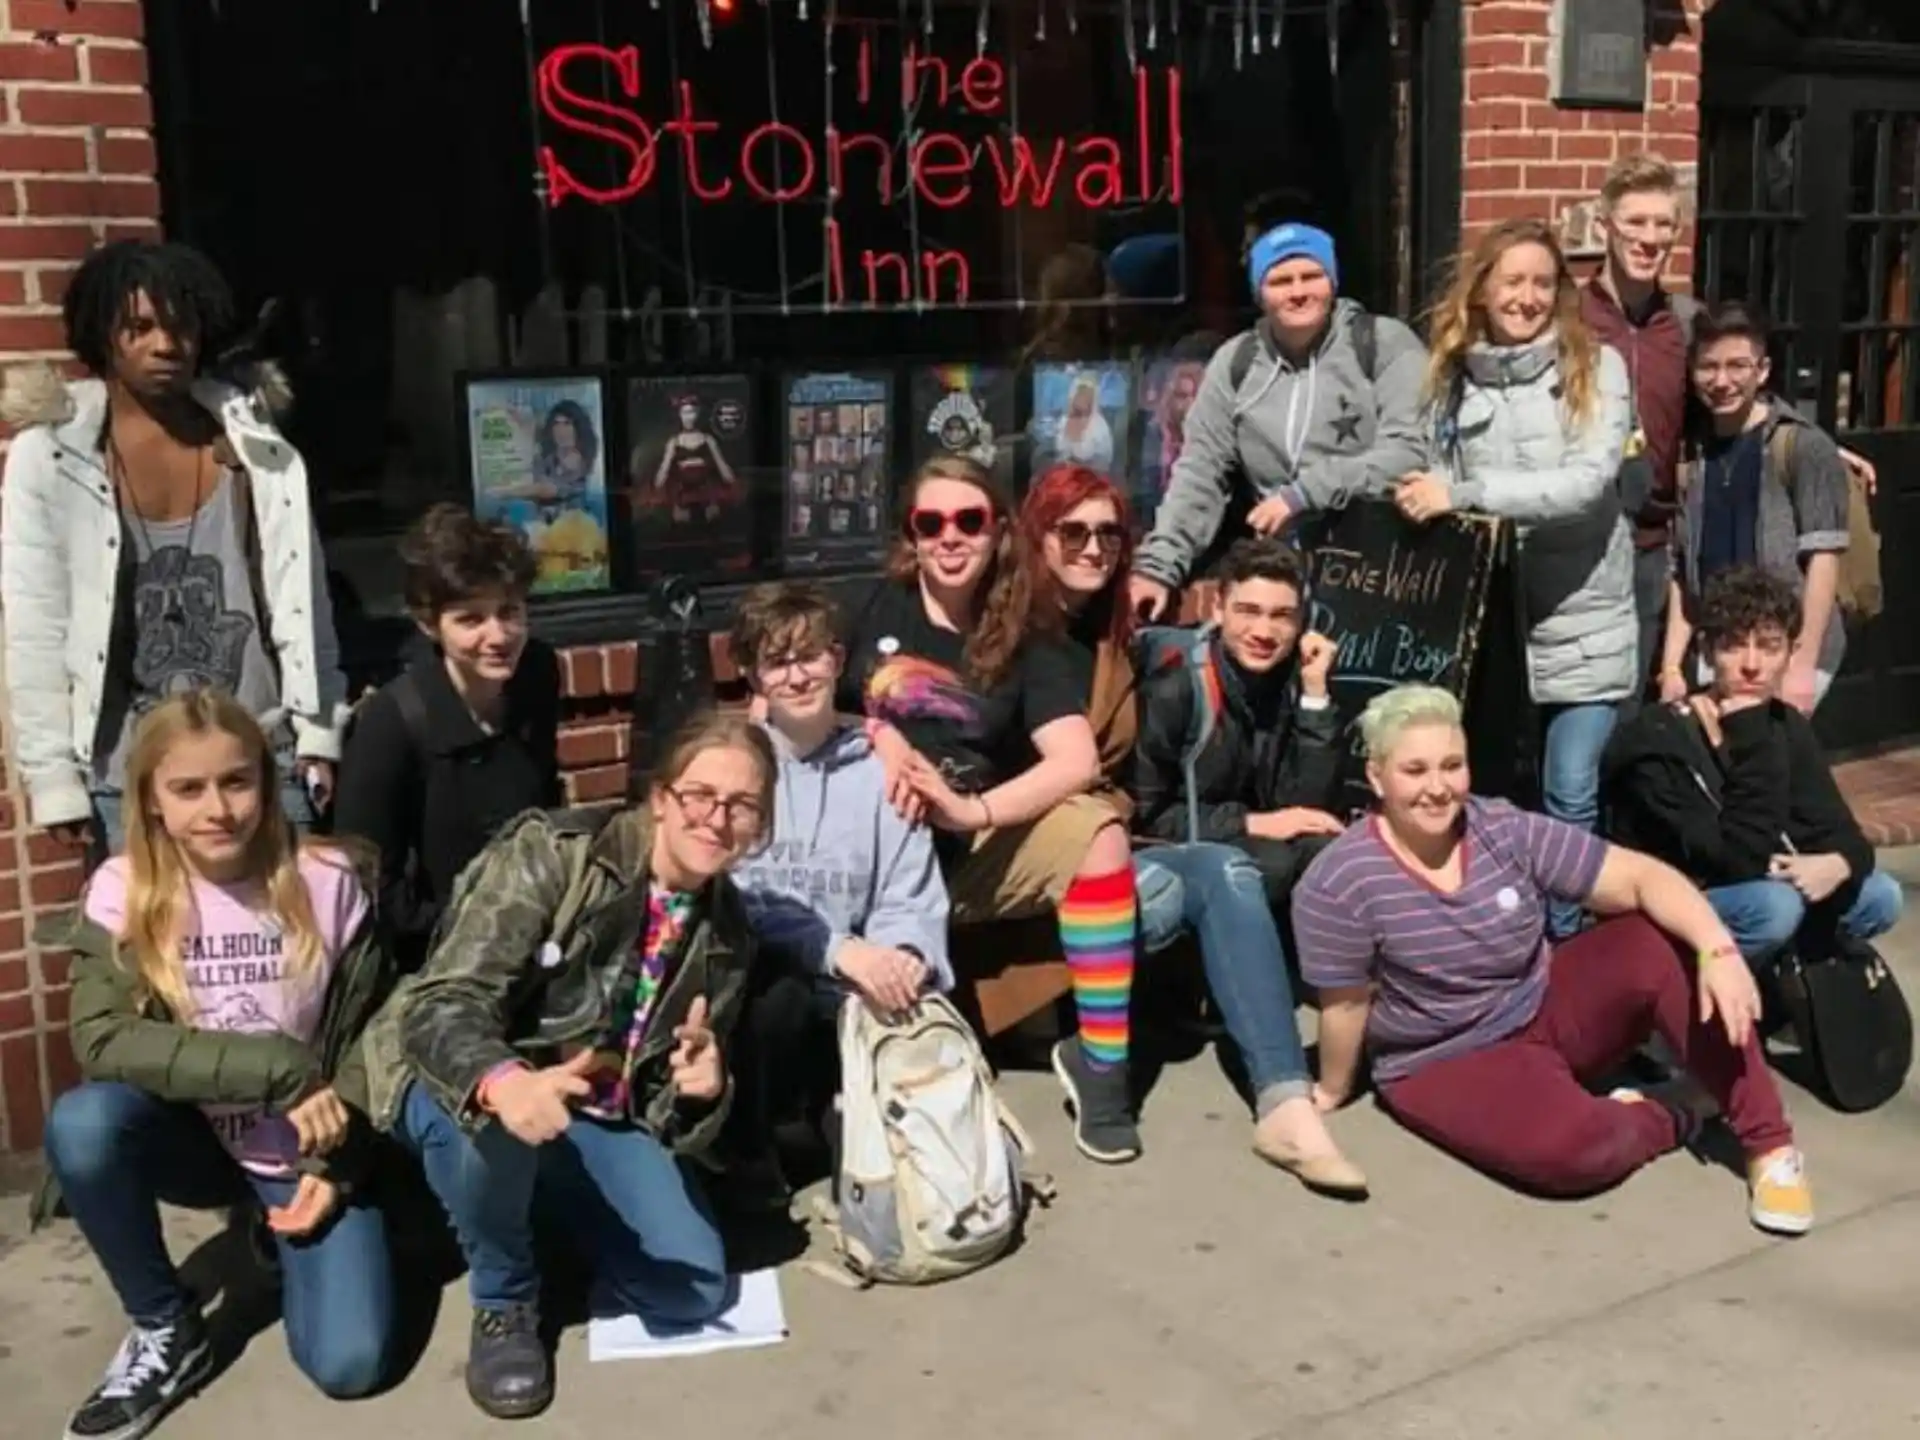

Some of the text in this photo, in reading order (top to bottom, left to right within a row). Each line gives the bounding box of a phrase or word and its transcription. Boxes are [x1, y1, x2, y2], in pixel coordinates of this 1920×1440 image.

[826, 17, 1004, 110] The
[538, 43, 1182, 207] Stonewall
[826, 217, 969, 309] Inn
